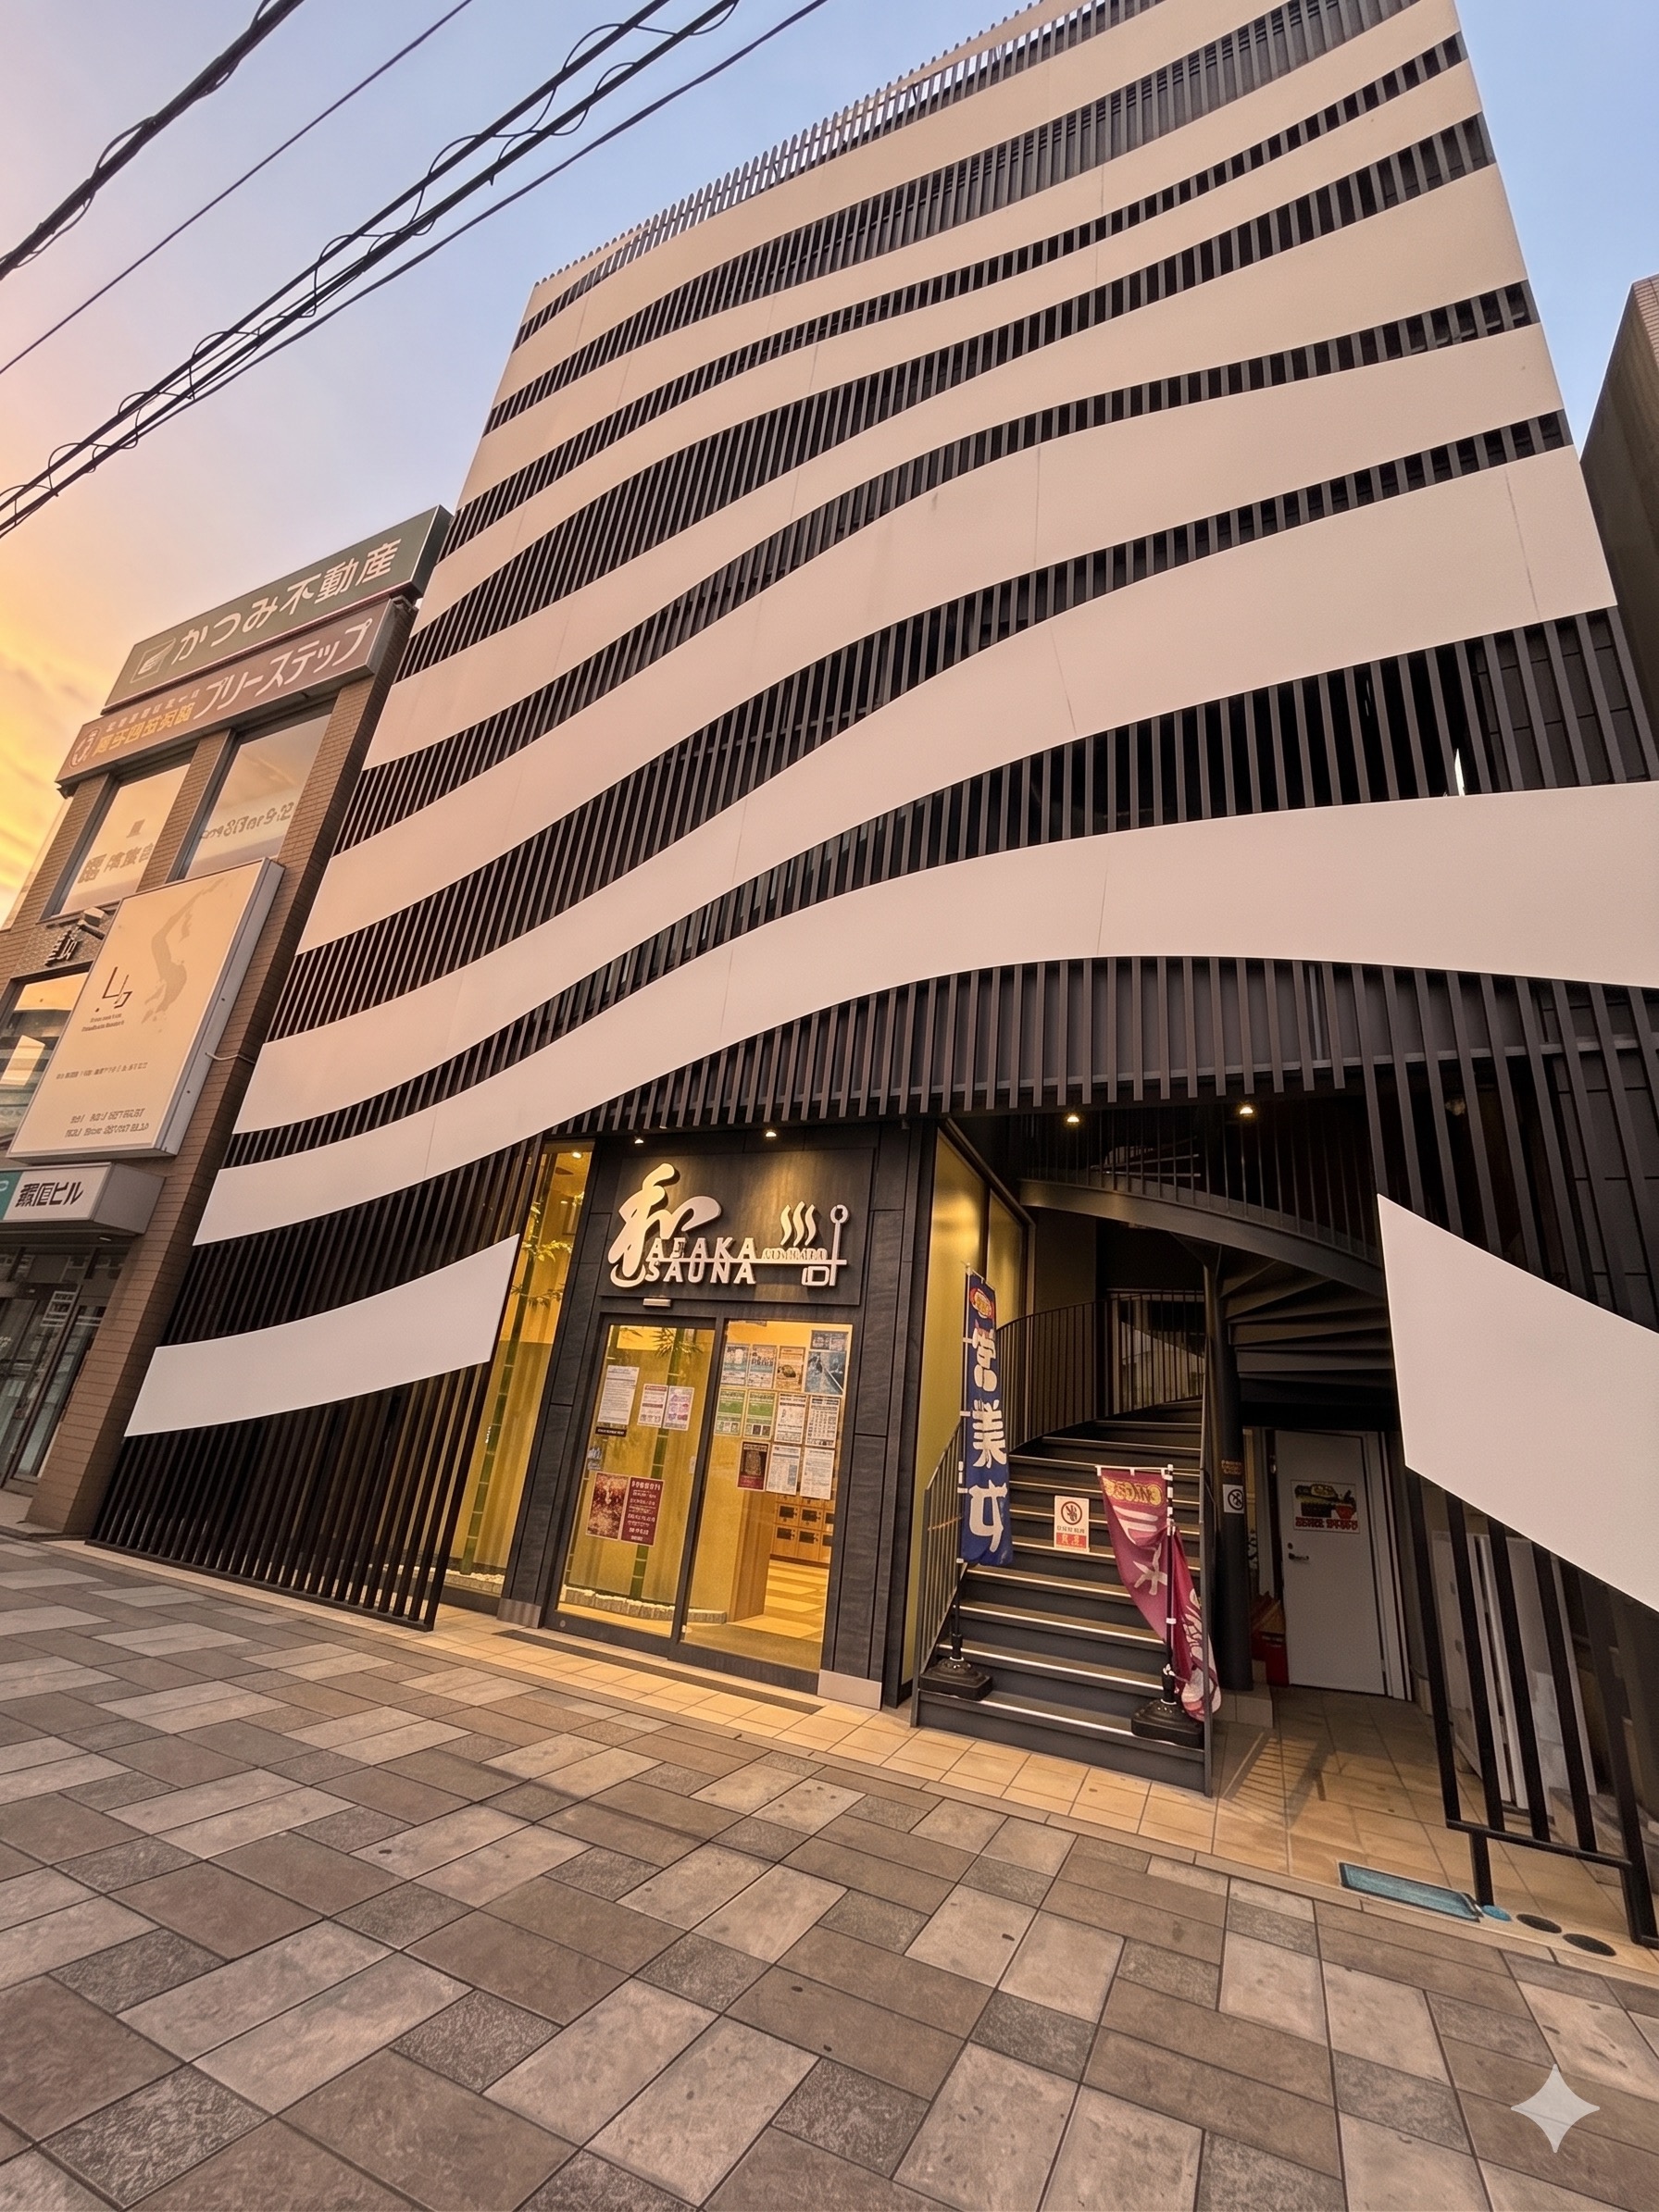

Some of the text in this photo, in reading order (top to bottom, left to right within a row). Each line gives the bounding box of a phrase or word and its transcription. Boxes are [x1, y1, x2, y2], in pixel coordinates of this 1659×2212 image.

[171, 539, 402, 665] かつみ不動産
[644, 1261, 756, 1286] SAUNA
